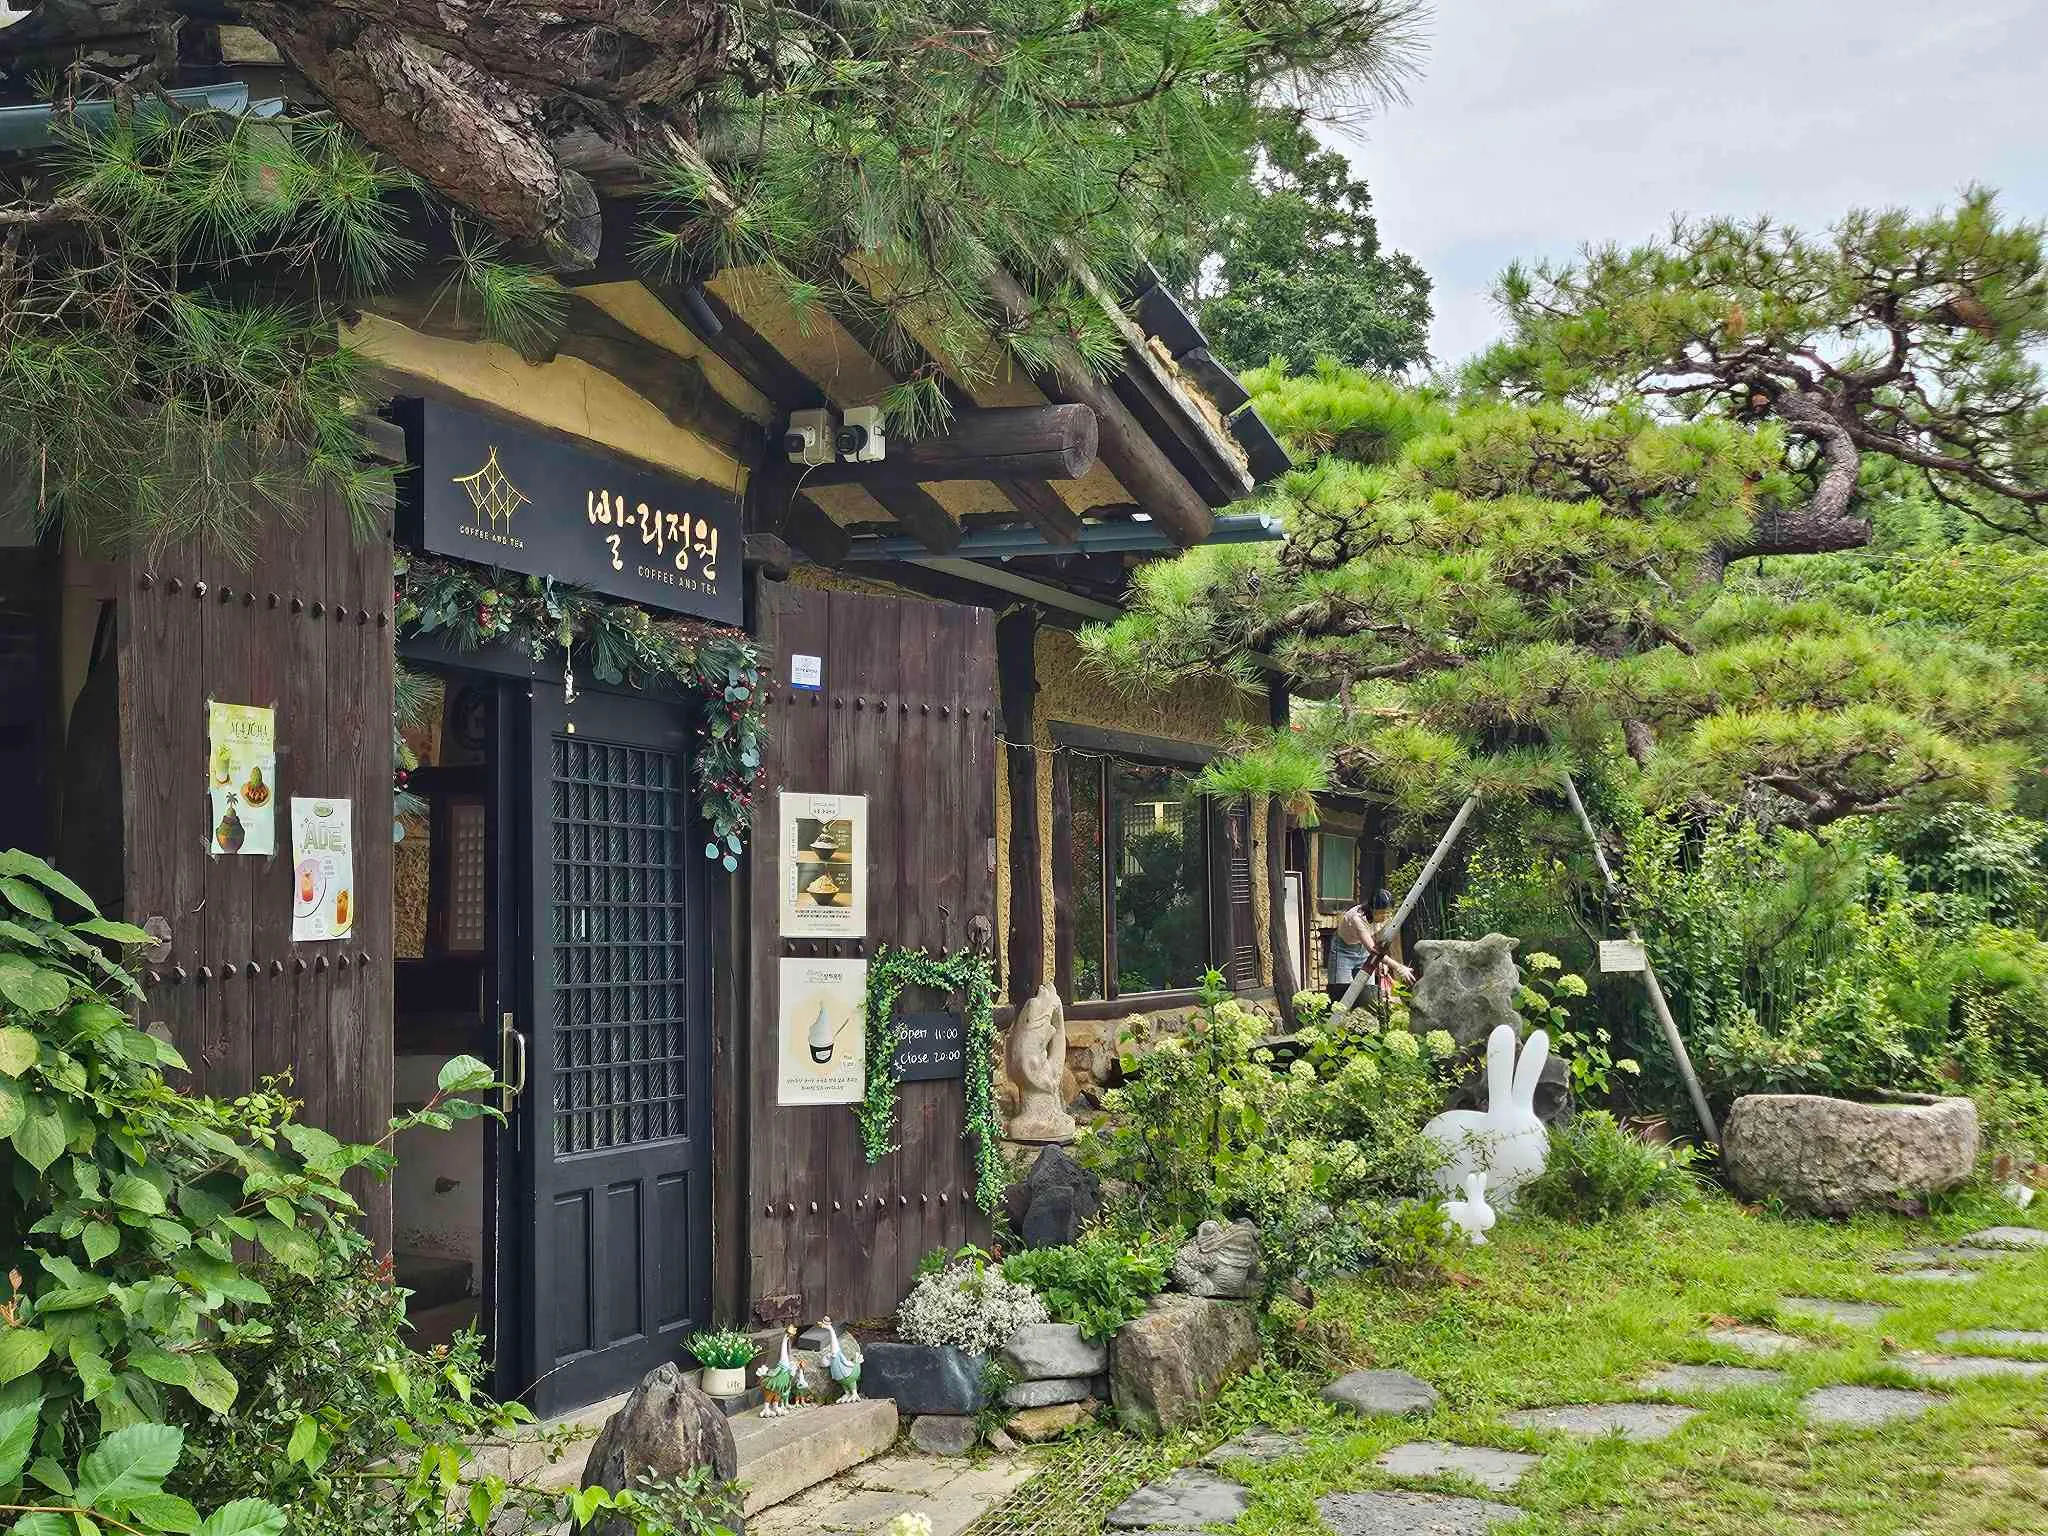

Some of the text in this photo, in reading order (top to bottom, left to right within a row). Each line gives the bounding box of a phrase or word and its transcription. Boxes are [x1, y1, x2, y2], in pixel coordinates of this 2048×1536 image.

[459, 526, 524, 550] COFFEE AND TEA
[638, 565, 717, 596] COFFEE AND TEA
[935, 1027, 958, 1040] 11:00
[934, 1049, 960, 1063] 20:00
